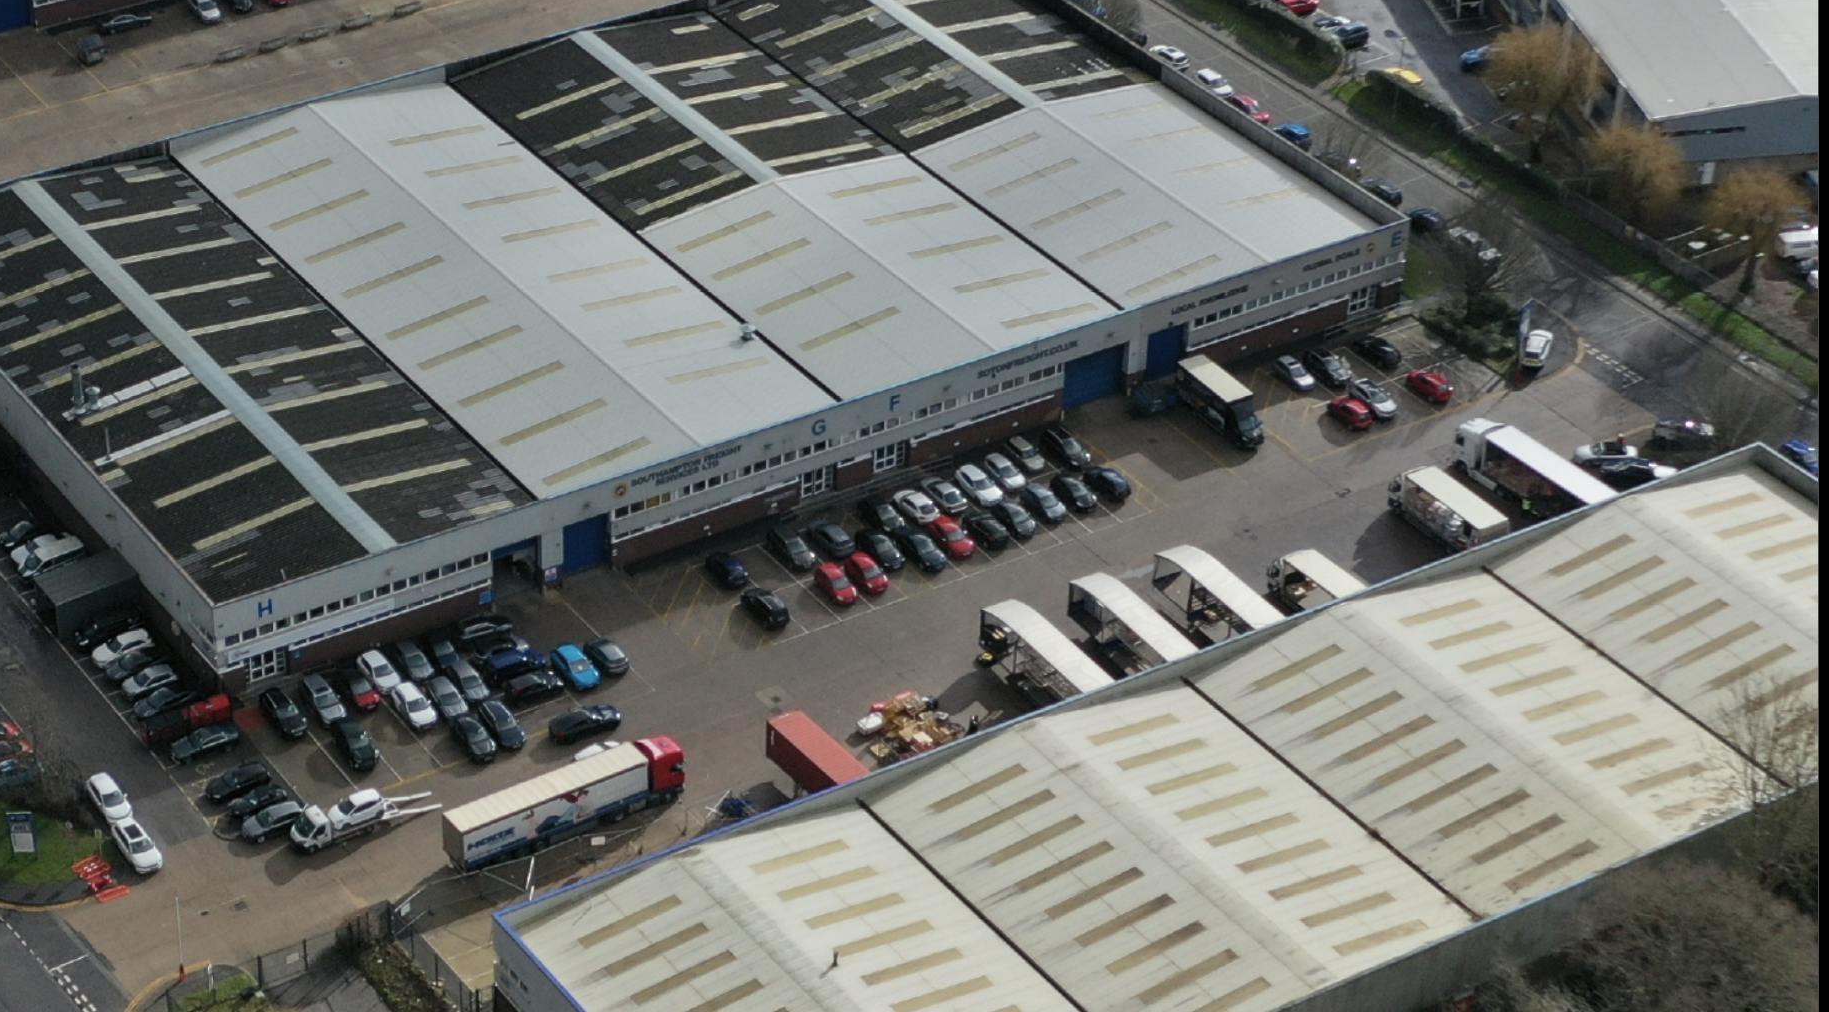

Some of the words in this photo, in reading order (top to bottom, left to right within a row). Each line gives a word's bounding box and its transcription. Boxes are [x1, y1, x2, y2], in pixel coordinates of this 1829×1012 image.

[1391, 231, 1402, 247] E
[1171, 301, 1197, 316] LOCAL
[889, 394, 901, 411] F
[811, 419, 826, 436] G
[631, 458, 702, 487] SOUTHAMPTON
[258, 598, 273, 618] H
